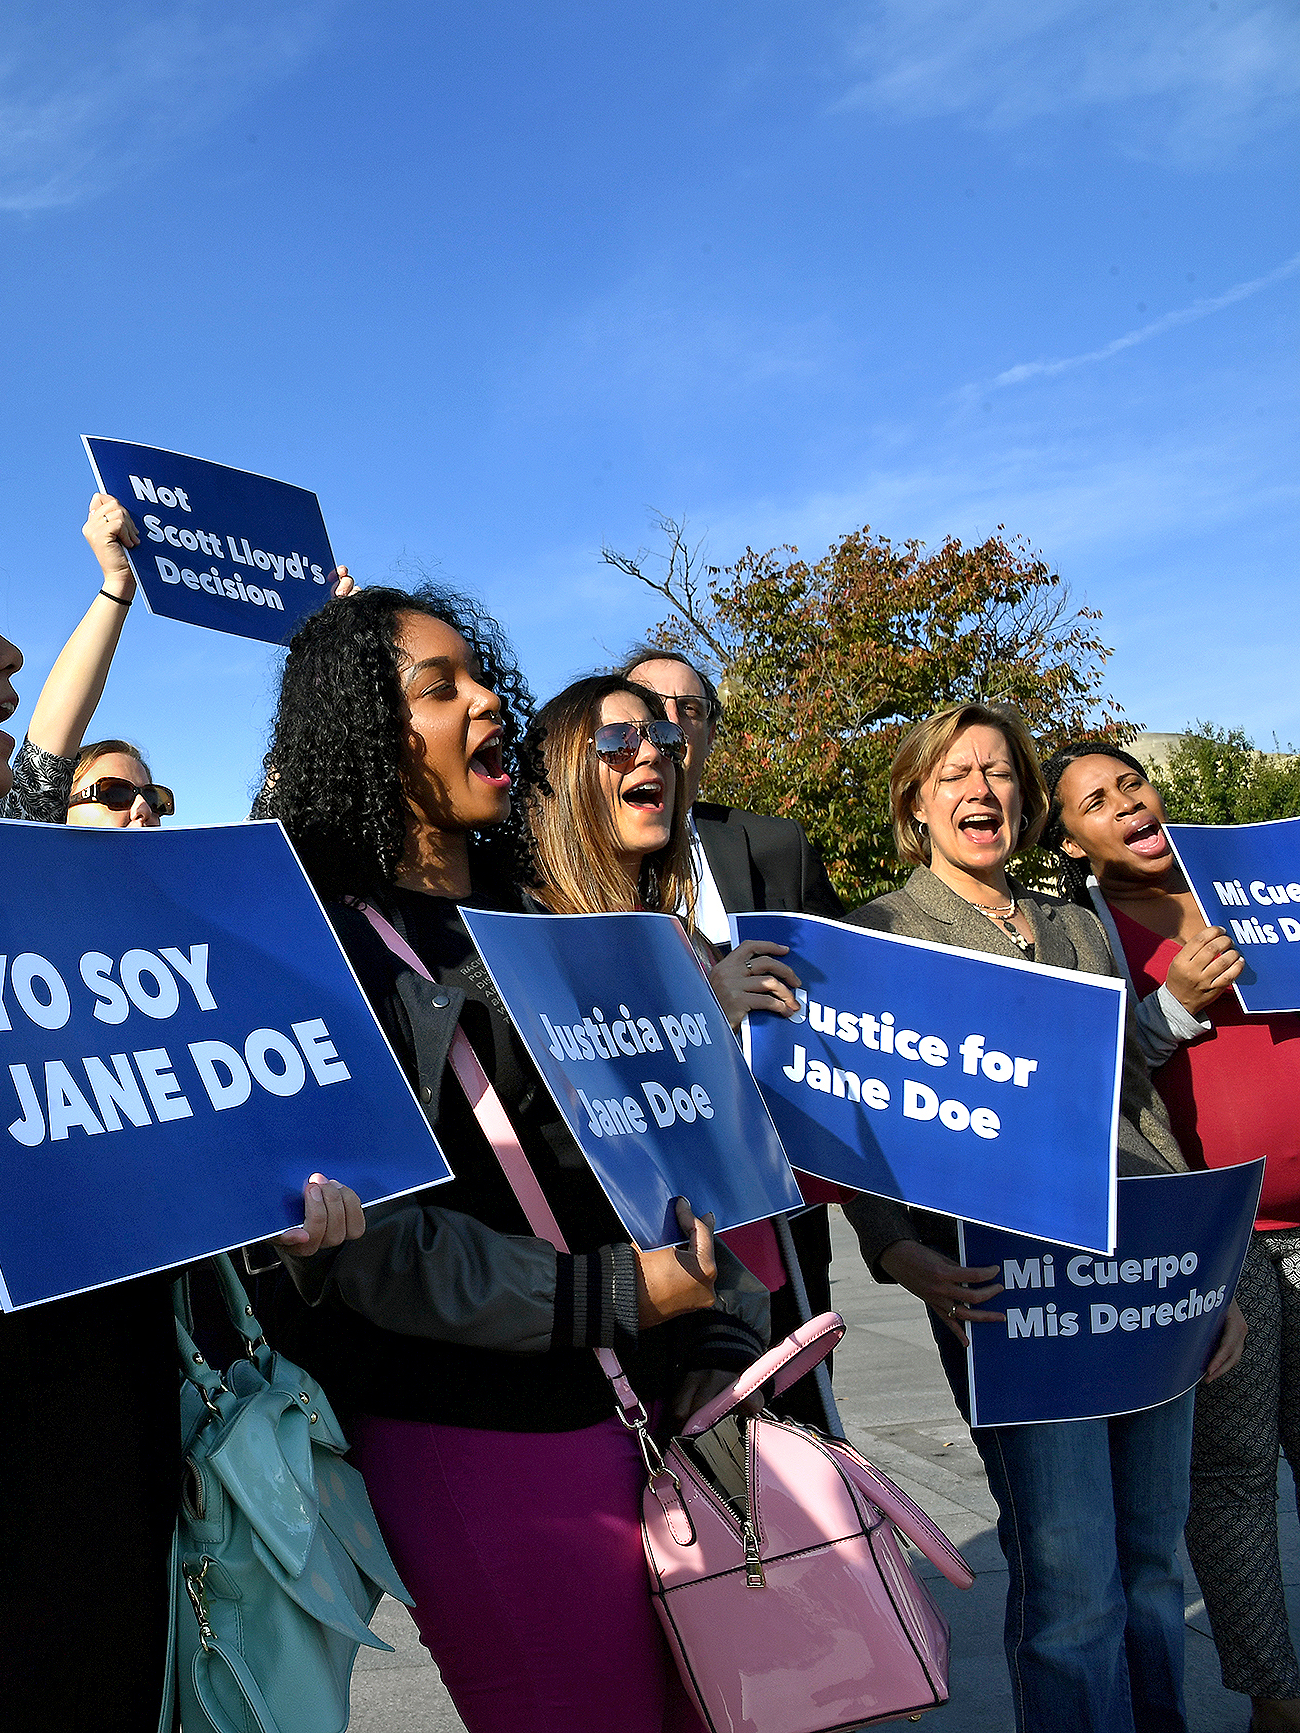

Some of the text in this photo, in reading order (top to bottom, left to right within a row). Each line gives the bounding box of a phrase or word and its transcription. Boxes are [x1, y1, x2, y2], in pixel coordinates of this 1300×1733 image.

[128, 474, 192, 513] Not
[143, 514, 326, 582] Scott Lloyd's
[154, 555, 285, 611] Decision
[1212, 879, 1251, 906] Mi
[1229, 916, 1280, 945] Mis
[79, 943, 218, 1025] SOY
[538, 1003, 664, 1062] Justicia
[658, 1012, 713, 1063] por
[958, 1034, 1039, 1088] for
[7, 1017, 352, 1147] JANE DOE
[576, 1081, 715, 1138] Jane Doe
[782, 1044, 1002, 1140] Jane Doe
[1003, 1251, 1198, 1290] Mi Cuerpo
[1006, 1284, 1227, 1339] Mis Derechos
